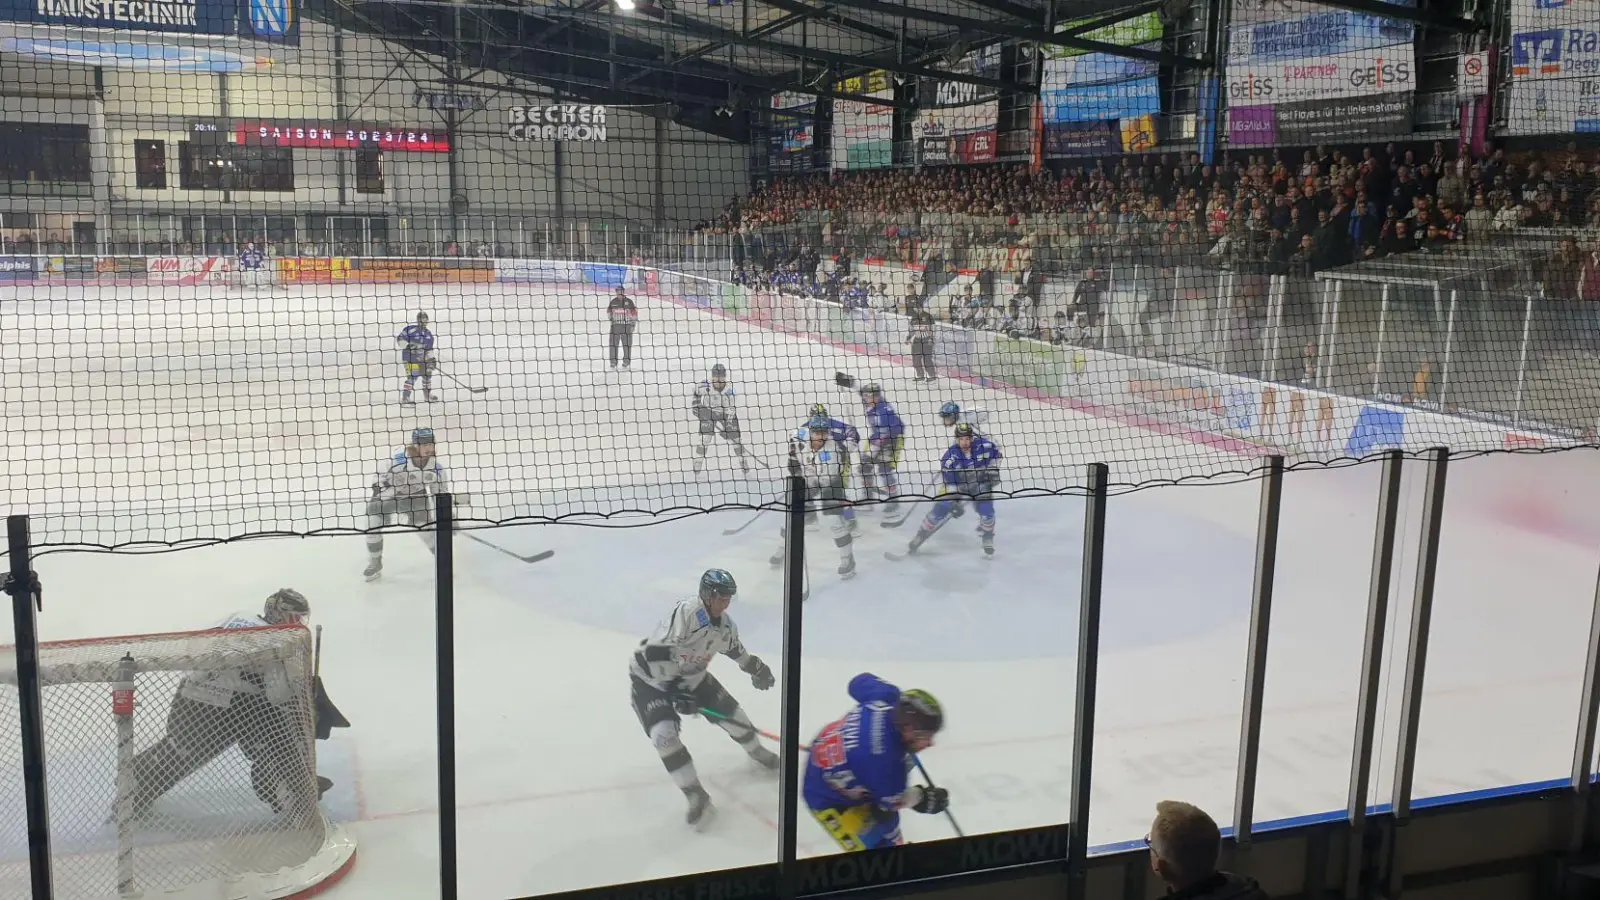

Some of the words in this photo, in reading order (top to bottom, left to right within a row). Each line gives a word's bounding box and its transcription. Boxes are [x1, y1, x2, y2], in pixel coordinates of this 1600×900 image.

[36, 0, 197, 26] HAUSTECHNIK
[936, 81, 977, 105] MOWI
[508, 106, 607, 124] BECKER
[260, 127, 332, 139] SAISON
[346, 130, 429, 143] 2023/24
[508, 124, 607, 142] CARBON
[151, 259, 180, 270] AVM
[963, 829, 1060, 870] MOWI
[798, 849, 905, 893] MOWI
